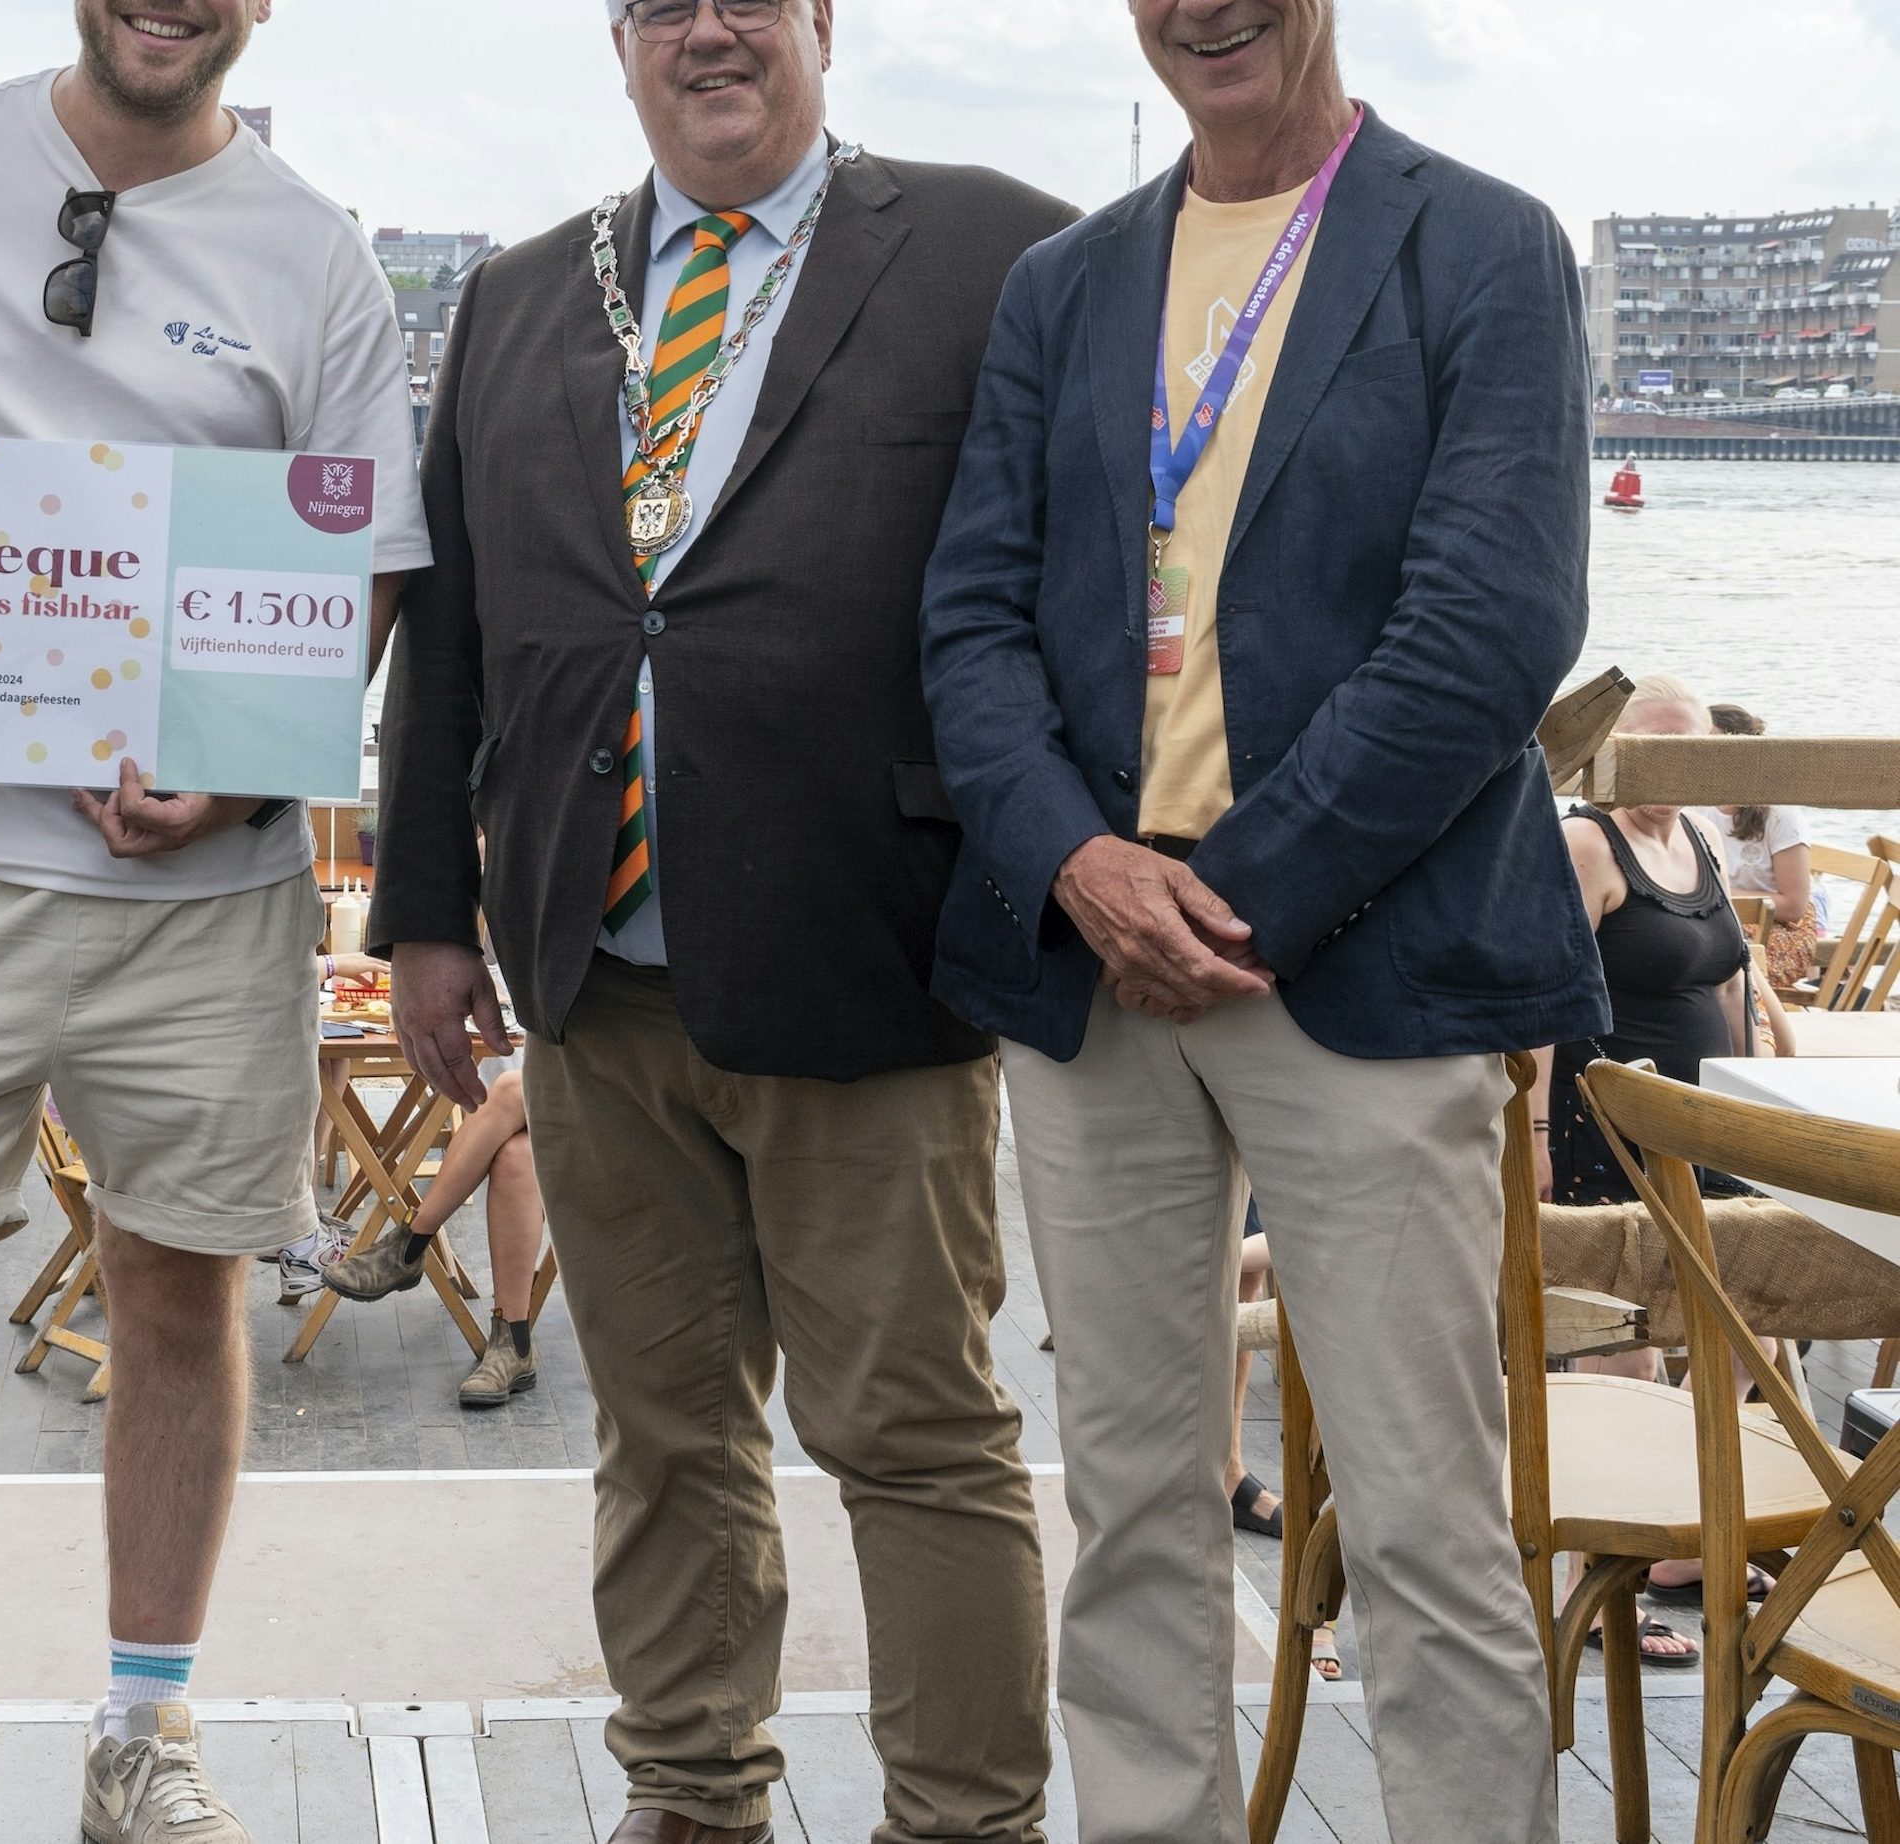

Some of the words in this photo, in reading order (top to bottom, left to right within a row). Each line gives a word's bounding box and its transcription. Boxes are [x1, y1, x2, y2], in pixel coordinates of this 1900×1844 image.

[1274, 242, 1294, 262] de
[1244, 261, 1283, 319] feesten
[193, 326, 214, 340] La
[192, 341, 219, 356] Club
[307, 500, 365, 518] Nijmegen
[20, 591, 140, 622] fishbar
[176, 589, 213, 622] €
[226, 591, 355, 630] 1.500
[179, 637, 304, 658] Vijftienhonderd
[307, 645, 345, 659] euro
